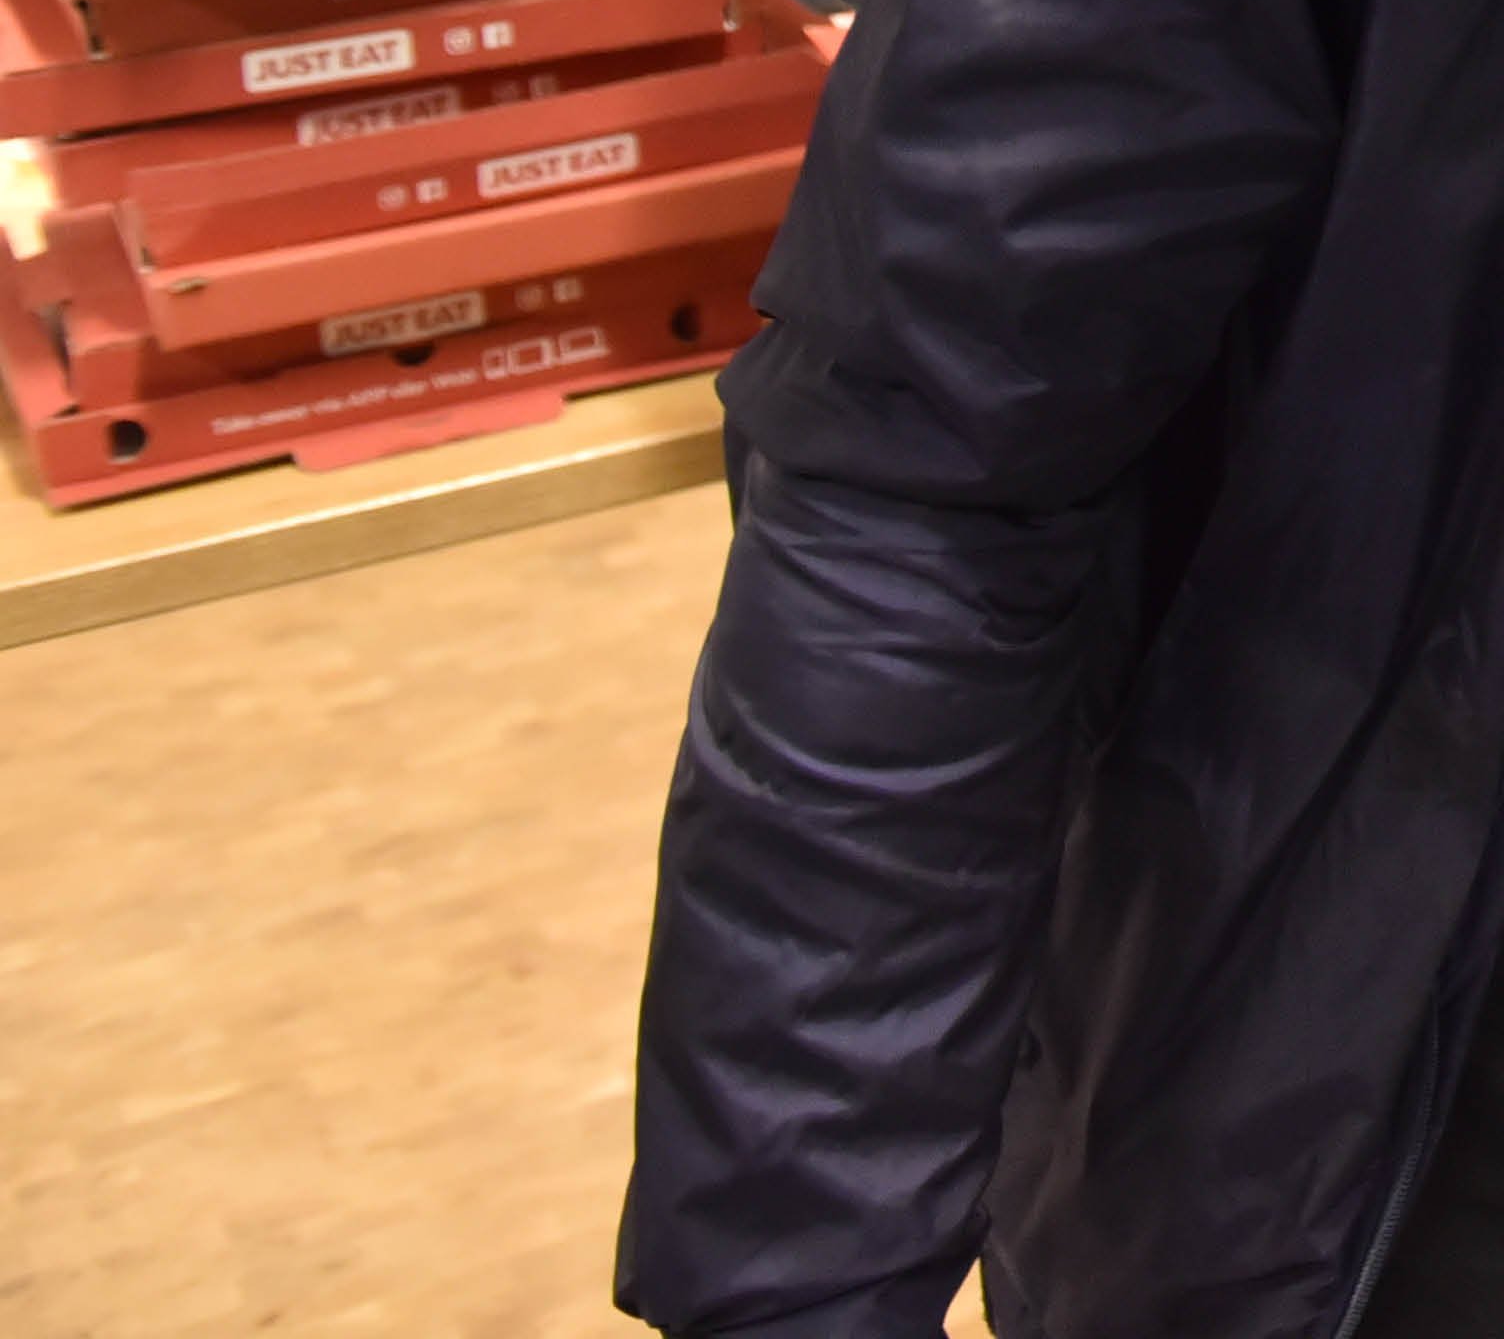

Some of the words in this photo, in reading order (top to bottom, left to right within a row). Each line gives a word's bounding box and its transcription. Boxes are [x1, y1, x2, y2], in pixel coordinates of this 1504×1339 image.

[255, 49, 333, 82] JUST
[341, 39, 400, 70] EAT
[487, 156, 563, 190] JUST
[570, 143, 628, 175] EAT
[328, 310, 401, 345] JUST
[405, 299, 472, 333] EAT
